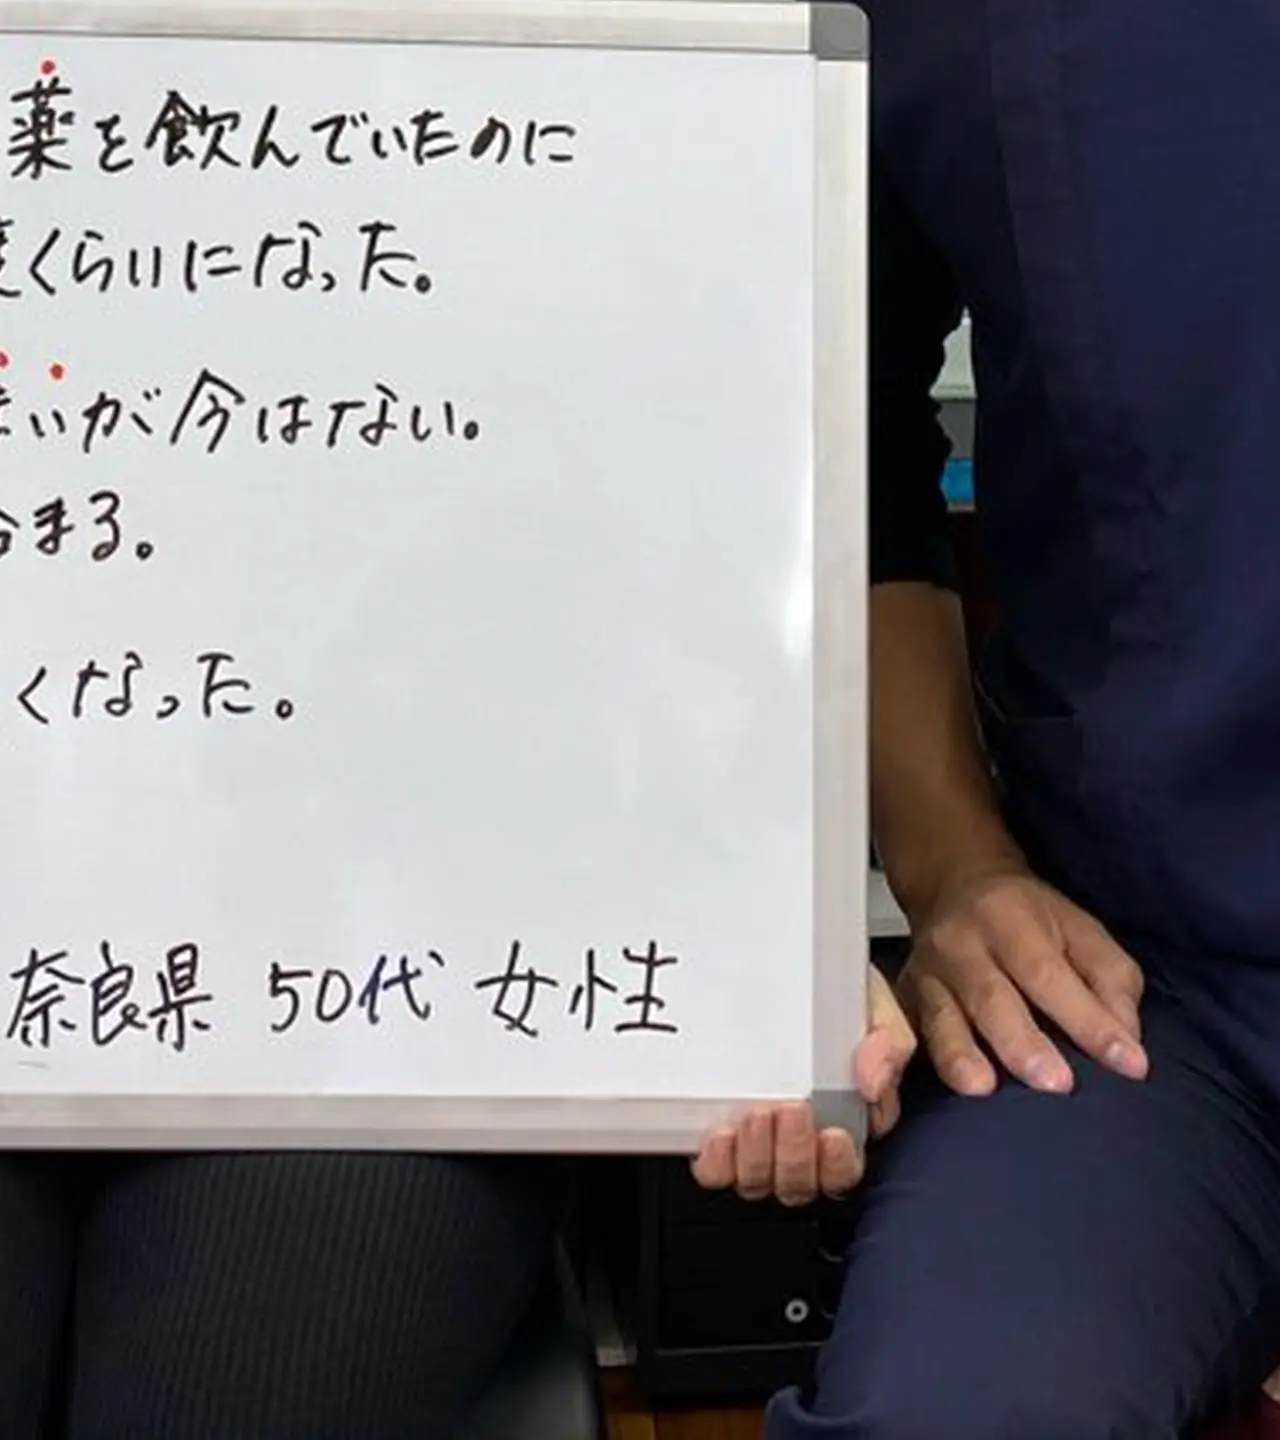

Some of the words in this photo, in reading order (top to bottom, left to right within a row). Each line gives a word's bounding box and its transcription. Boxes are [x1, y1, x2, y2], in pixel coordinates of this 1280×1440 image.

[6, 941, 214, 1052] 奈良県
[270, 949, 446, 1032] 50代
[475, 940, 679, 1038] 女性
